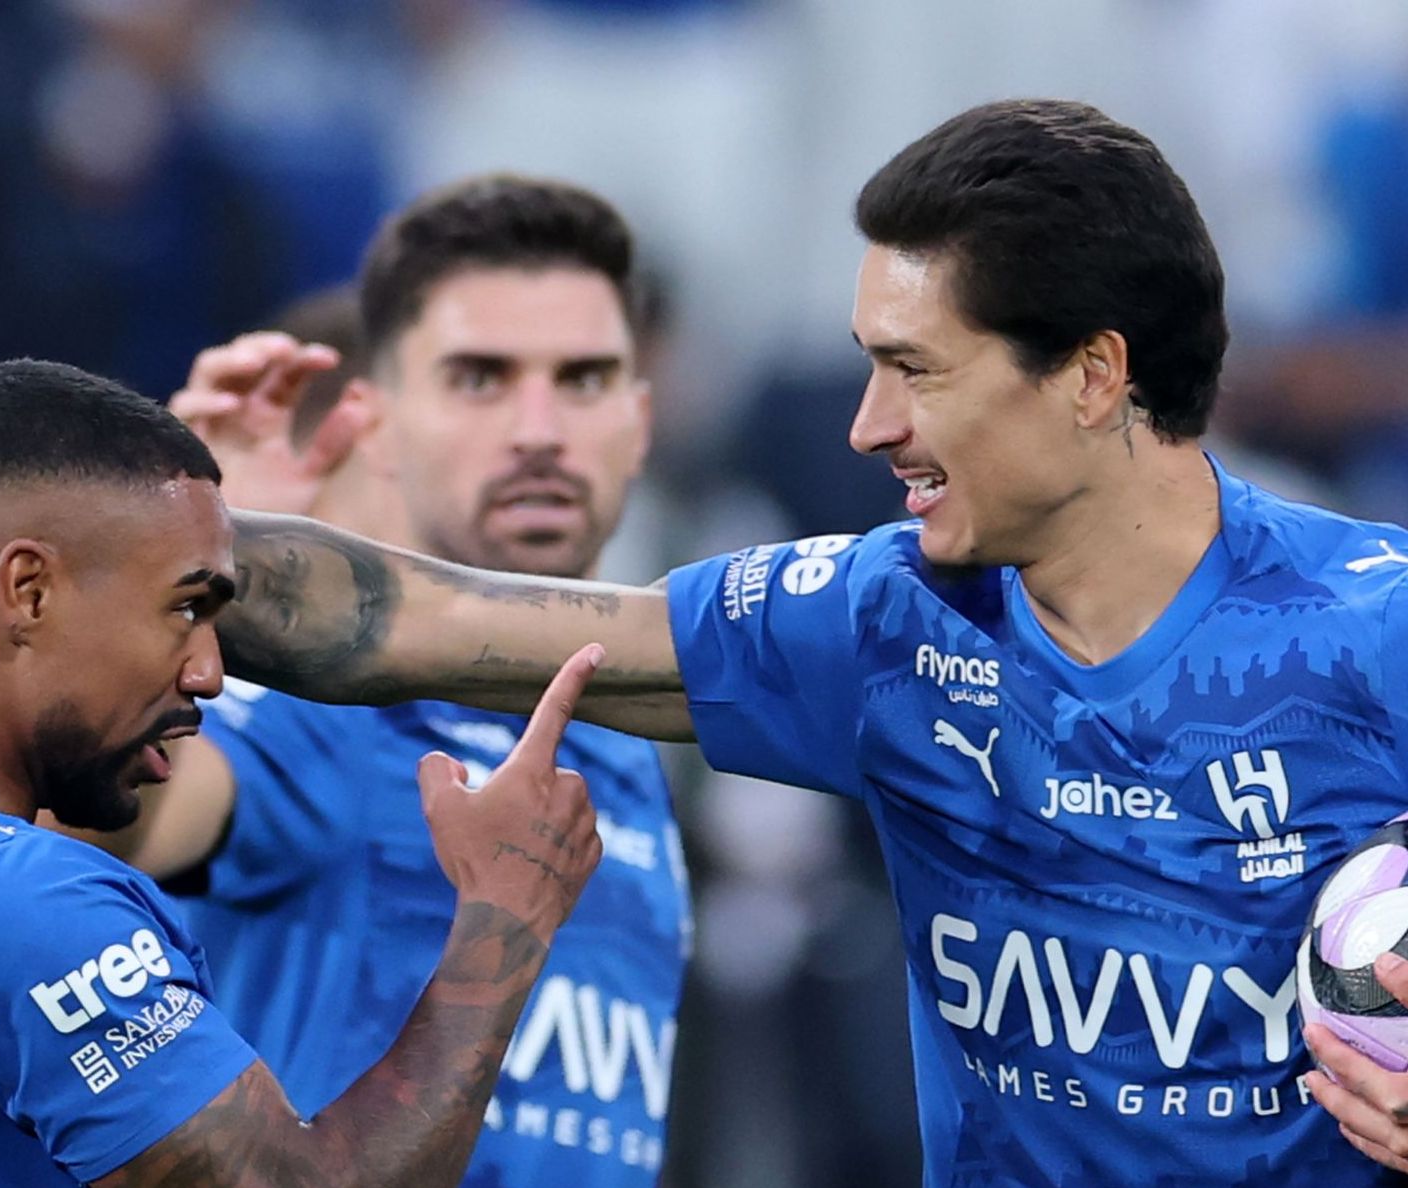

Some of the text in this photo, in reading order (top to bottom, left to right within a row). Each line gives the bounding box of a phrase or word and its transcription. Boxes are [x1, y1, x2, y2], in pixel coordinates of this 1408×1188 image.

[782, 534, 852, 596] ee
[915, 643, 1000, 687] flynas
[28, 928, 172, 1035] tree
[930, 912, 1297, 1070] SAVVY
